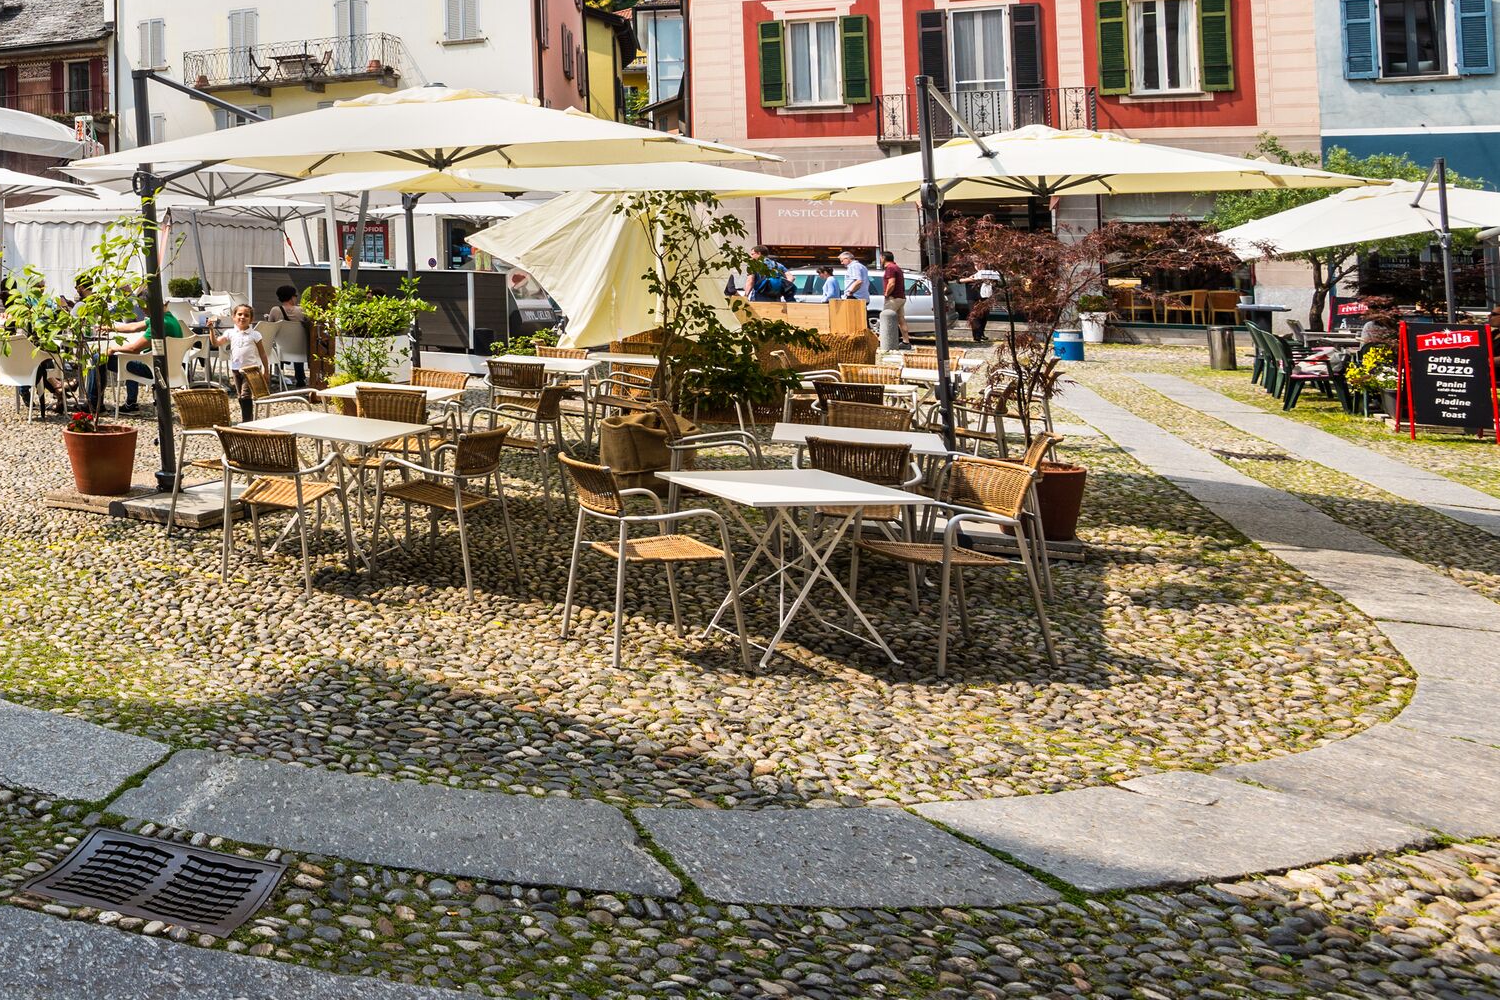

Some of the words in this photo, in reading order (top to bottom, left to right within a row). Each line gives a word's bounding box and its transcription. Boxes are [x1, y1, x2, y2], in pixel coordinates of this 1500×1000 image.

[778, 208, 860, 218] PASTICCERIA
[1424, 333, 1471, 347] rivella
[1428, 356, 1452, 364] Caffè
[1453, 357, 1471, 365] Bar
[1427, 363, 1474, 375] Pozzo
[1436, 380, 1467, 389] Panini
[1435, 398, 1472, 407] Piadine
[1441, 411, 1467, 419] Toast
